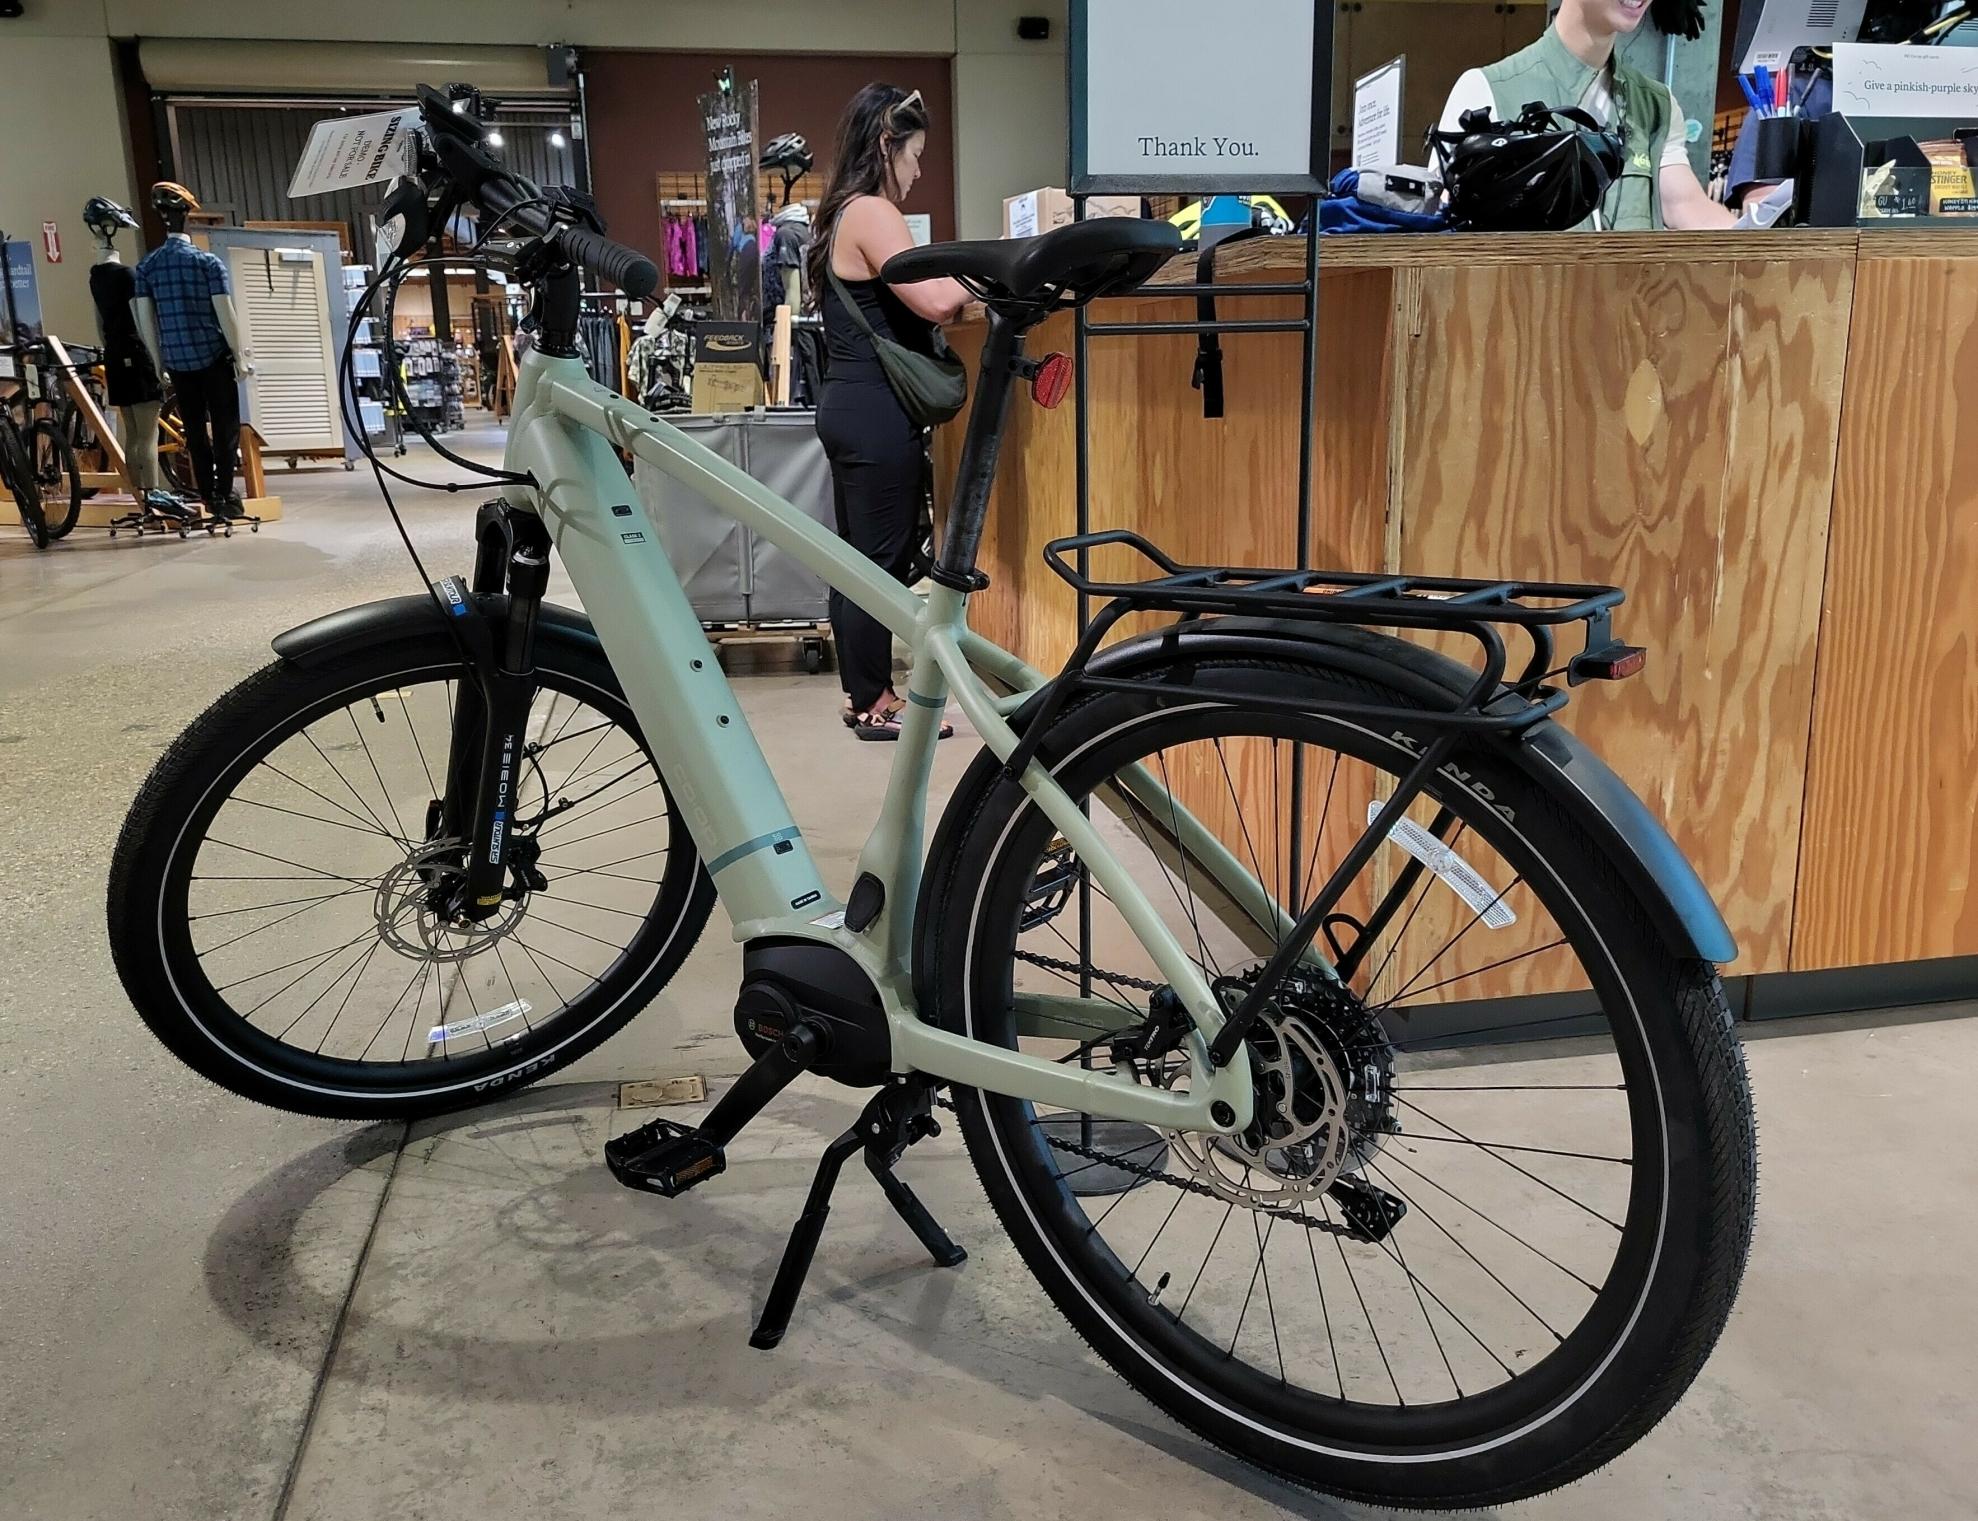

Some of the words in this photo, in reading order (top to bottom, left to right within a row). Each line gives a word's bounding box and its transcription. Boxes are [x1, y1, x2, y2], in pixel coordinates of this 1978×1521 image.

[1864, 80, 1885, 91] Give
[1894, 80, 1961, 95] pinkish-purple
[377, 116, 402, 153] SIZING
[1138, 136, 1207, 157] Thank
[1212, 137, 1259, 157] You.
[365, 152, 386, 180] BIKE
[1930, 175, 1968, 184] STINGER
[1878, 195, 1888, 206] GU
[1390, 730, 1516, 823] KNDA
[473, 1054, 556, 1093] KENDA
